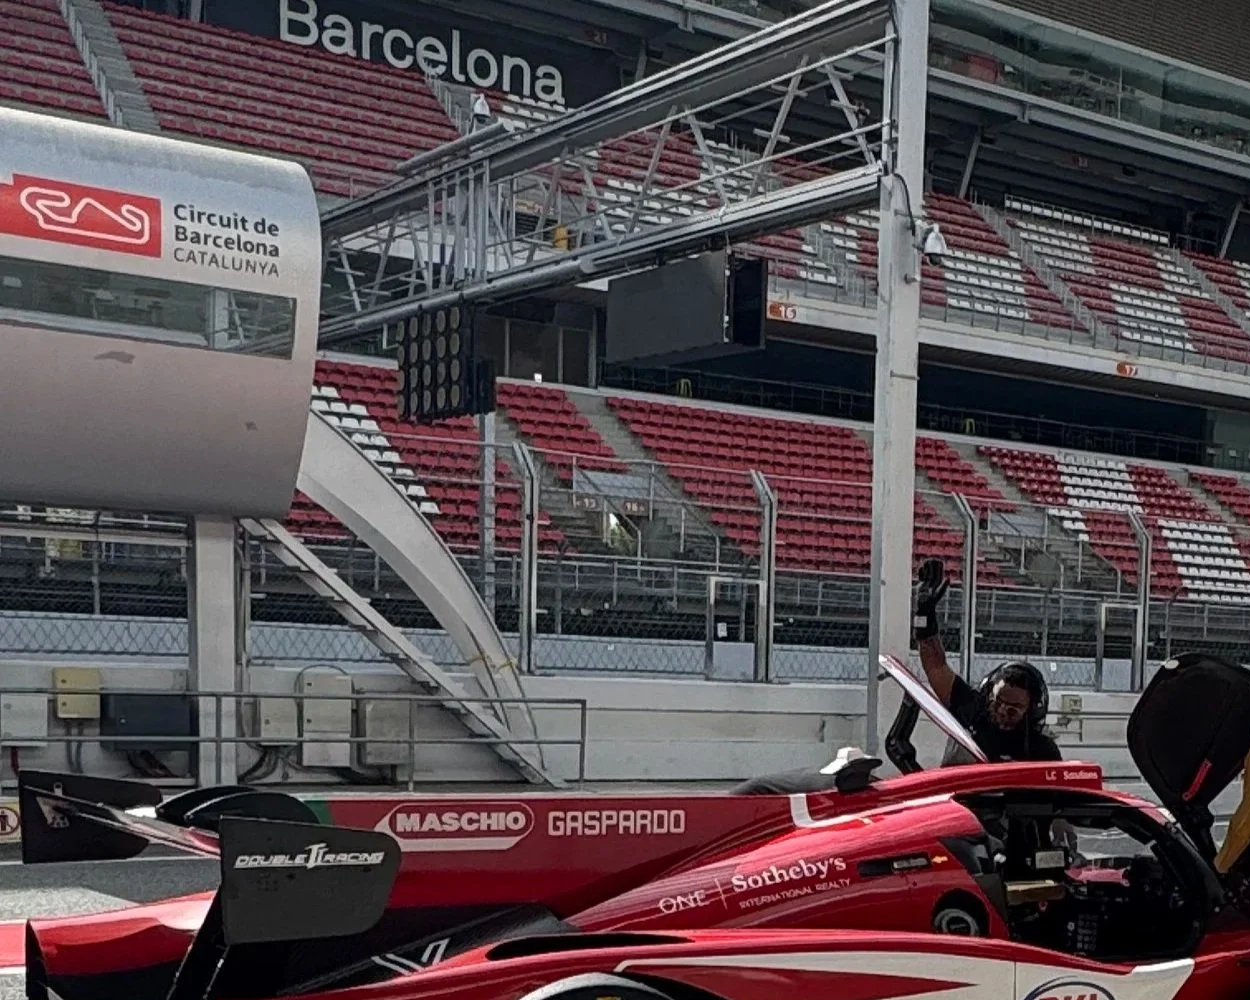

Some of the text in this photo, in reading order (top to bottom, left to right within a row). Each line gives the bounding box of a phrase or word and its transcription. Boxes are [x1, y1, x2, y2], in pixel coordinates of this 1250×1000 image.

[279, 0, 565, 105] Barcelona
[174, 204, 279, 236] Circuit de
[175, 225, 279, 257] Barcelona
[174, 248, 279, 278] CATALUNYA
[396, 810, 686, 836] MASCHIO GASPARDO
[235, 854, 306, 867] DOUBLE
[323, 852, 385, 865] RACING
[731, 857, 847, 893] Sotheby's
